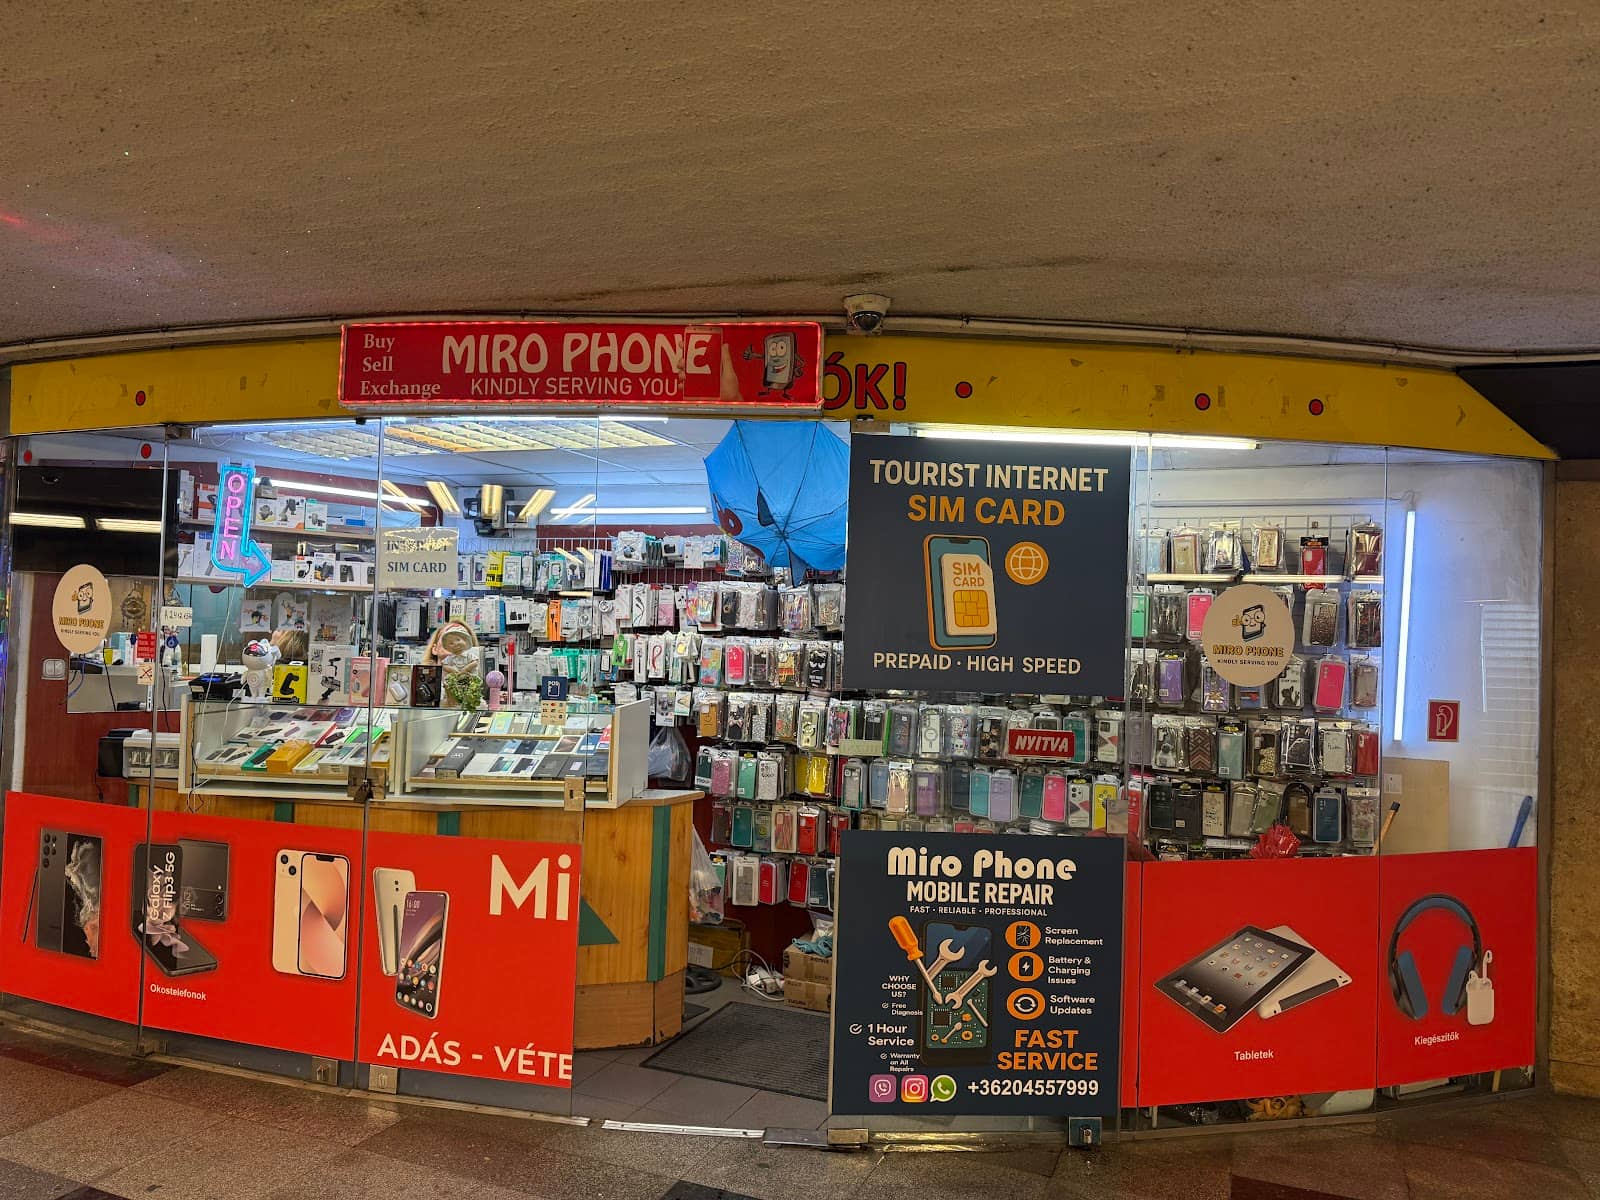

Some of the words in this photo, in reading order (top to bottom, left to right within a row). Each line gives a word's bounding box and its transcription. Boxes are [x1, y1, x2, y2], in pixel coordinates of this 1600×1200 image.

[363, 333, 395, 352] Buy
[442, 333, 548, 374] MIRO
[563, 332, 713, 375] PHONE
[362, 356, 393, 372] Sell
[360, 380, 441, 399] Exchange
[471, 378, 540, 395] KINDLY
[545, 377, 633, 395] SERVING
[639, 378, 678, 396] YOU
[823, 352, 907, 410] ÓK!
[870, 459, 980, 488] TOURIST
[986, 465, 1109, 492] INTERNET
[220, 474, 245, 560] OPEN
[908, 494, 965, 522] SIM
[975, 497, 1065, 526] CARD
[387, 561, 409, 572] SIM
[413, 562, 447, 573] CARD
[952, 562, 981, 576] SIM
[953, 577, 985, 587] CARD
[1212, 644, 1243, 655] MIRO
[1246, 645, 1284, 657] PHONE
[873, 652, 951, 671] PREPAID
[967, 656, 1014, 673] HIGH
[1022, 657, 1081, 675] SPEED
[1014, 735, 1069, 753] NYITVA
[165, 851, 176, 872] 5G
[887, 847, 962, 877] Miro
[973, 849, 1077, 881] Phone
[148, 864, 165, 921] Galaxy
[163, 875, 177, 909] Flip3
[489, 853, 572, 921] Mi
[907, 880, 980, 903] MOBILE
[984, 882, 1054, 905] REPAIR
[909, 905, 930, 914] FAST
[938, 906, 976, 915] RELIABLE
[984, 907, 1048, 917] PROFESSIONAL
[1045, 926, 1079, 935] Screen
[1045, 936, 1104, 946] Replacement
[1048, 956, 1082, 965] Battery
[1084, 956, 1091, 964] &
[889, 975, 910, 983] WHY
[1048, 965, 1091, 976] Charging
[1047, 976, 1077, 985] Issues
[150, 983, 207, 1001] Okostelefonok
[1050, 994, 1096, 1004] Software
[891, 1009, 924, 1017] Diagnosis
[1050, 1005, 1093, 1016] Updates
[867, 1023, 874, 1034] 1
[876, 1023, 908, 1034] Hour
[867, 1035, 915, 1047] Service
[1015, 1029, 1079, 1049] FAST
[376, 1031, 462, 1067] ADÁS
[890, 1052, 921, 1060] Warranty
[1233, 1049, 1275, 1061] Tabletek
[997, 1051, 1099, 1071] SERVICE
[967, 1079, 1099, 1096] +36204557999
